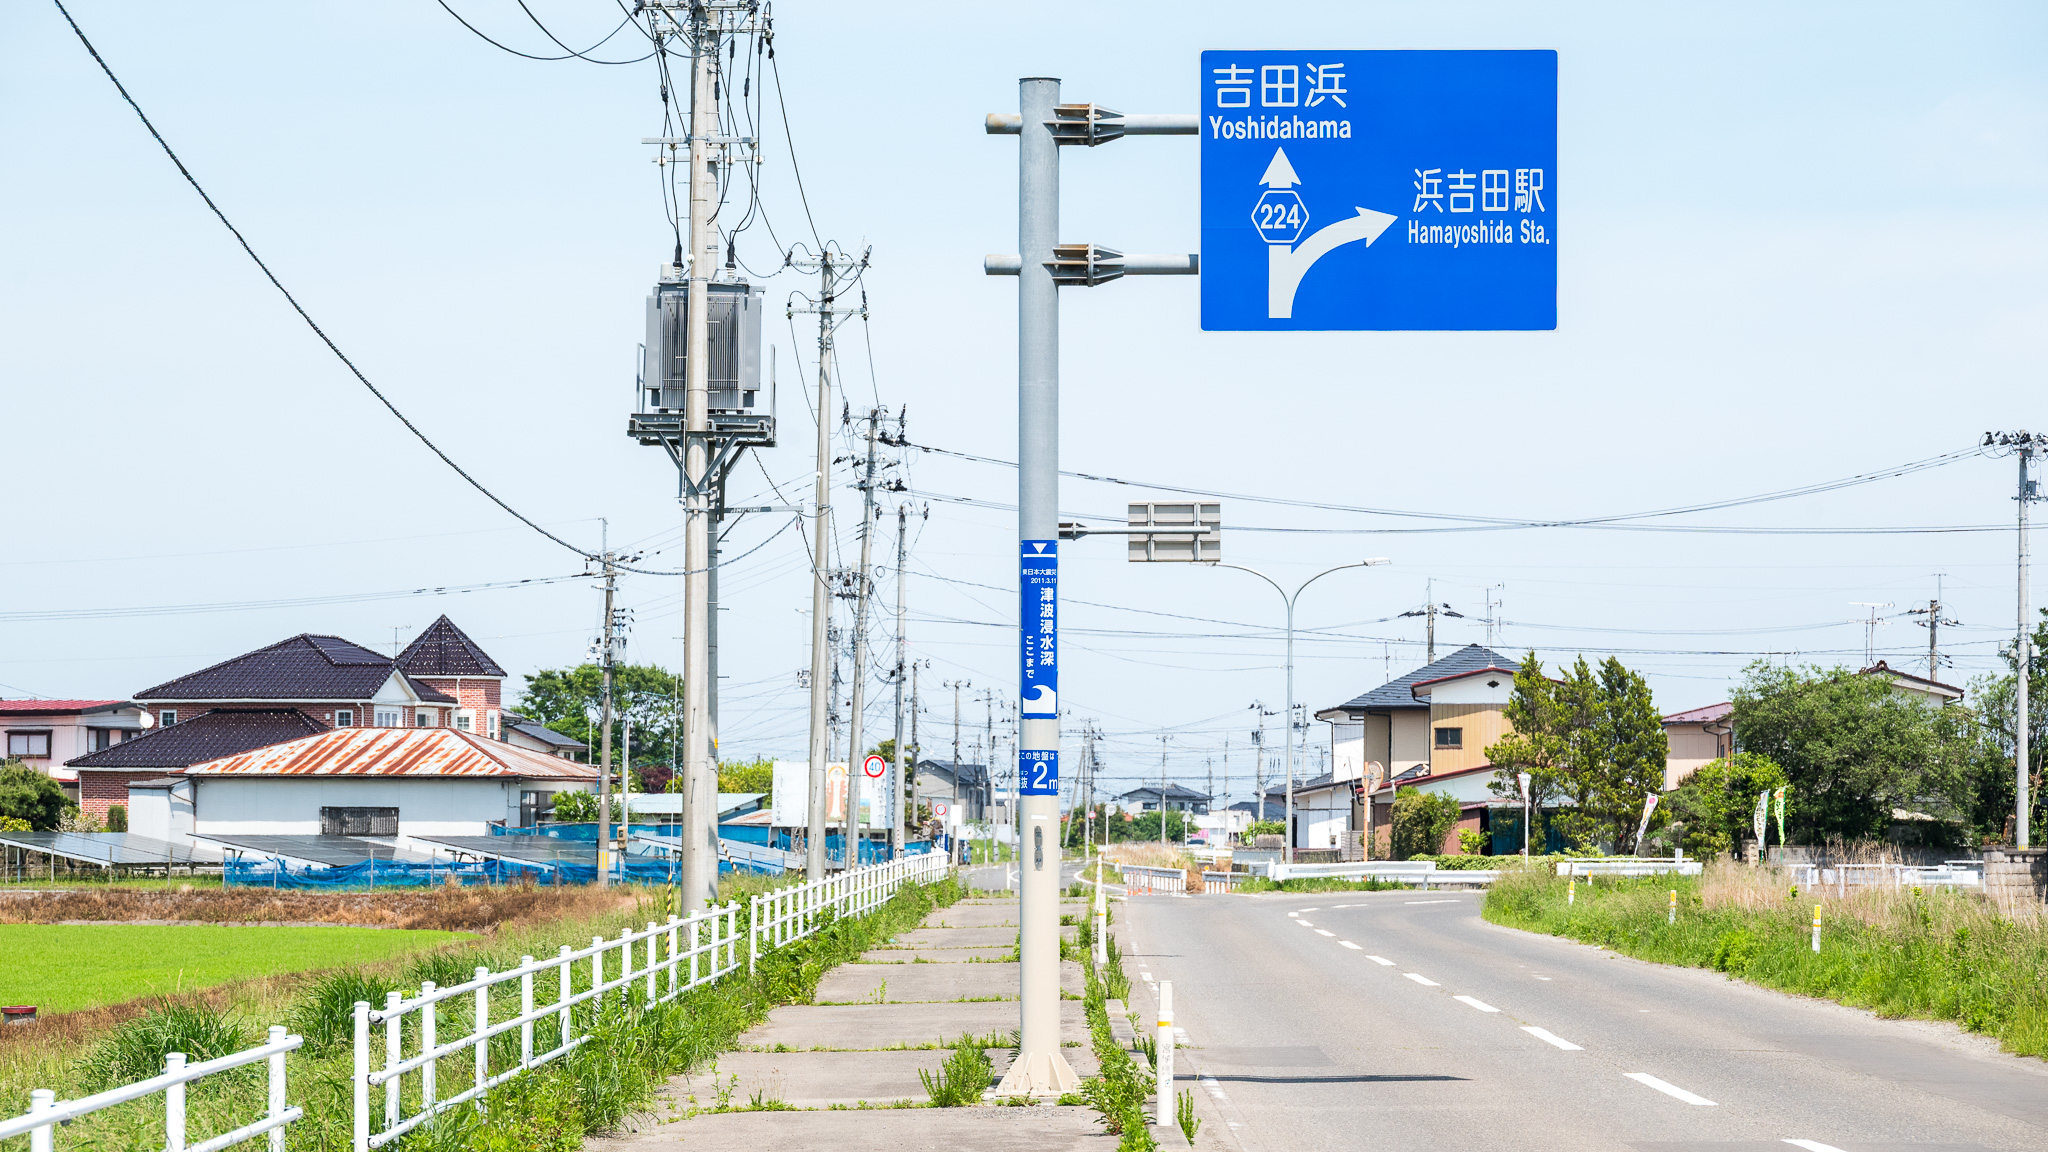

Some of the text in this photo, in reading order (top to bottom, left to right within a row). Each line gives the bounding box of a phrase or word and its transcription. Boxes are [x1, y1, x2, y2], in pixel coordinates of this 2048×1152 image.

[1213, 62, 1348, 109] 吉田浜
[1209, 115, 1352, 140] Yoshidahama
[1412, 167, 1546, 214] 浜吉田駅
[1260, 203, 1301, 230] 224
[1408, 218, 1550, 248] Hamayoshida Sta.
[1022, 568, 1057, 576] 東日本大震災
[1039, 586, 1055, 667] 津波浸水深
[1025, 635, 1035, 679] ここまで
[868, 761, 881, 772] 40
[1019, 751, 1054, 761] この地盤は
[1033, 761, 1057, 789] 2m
